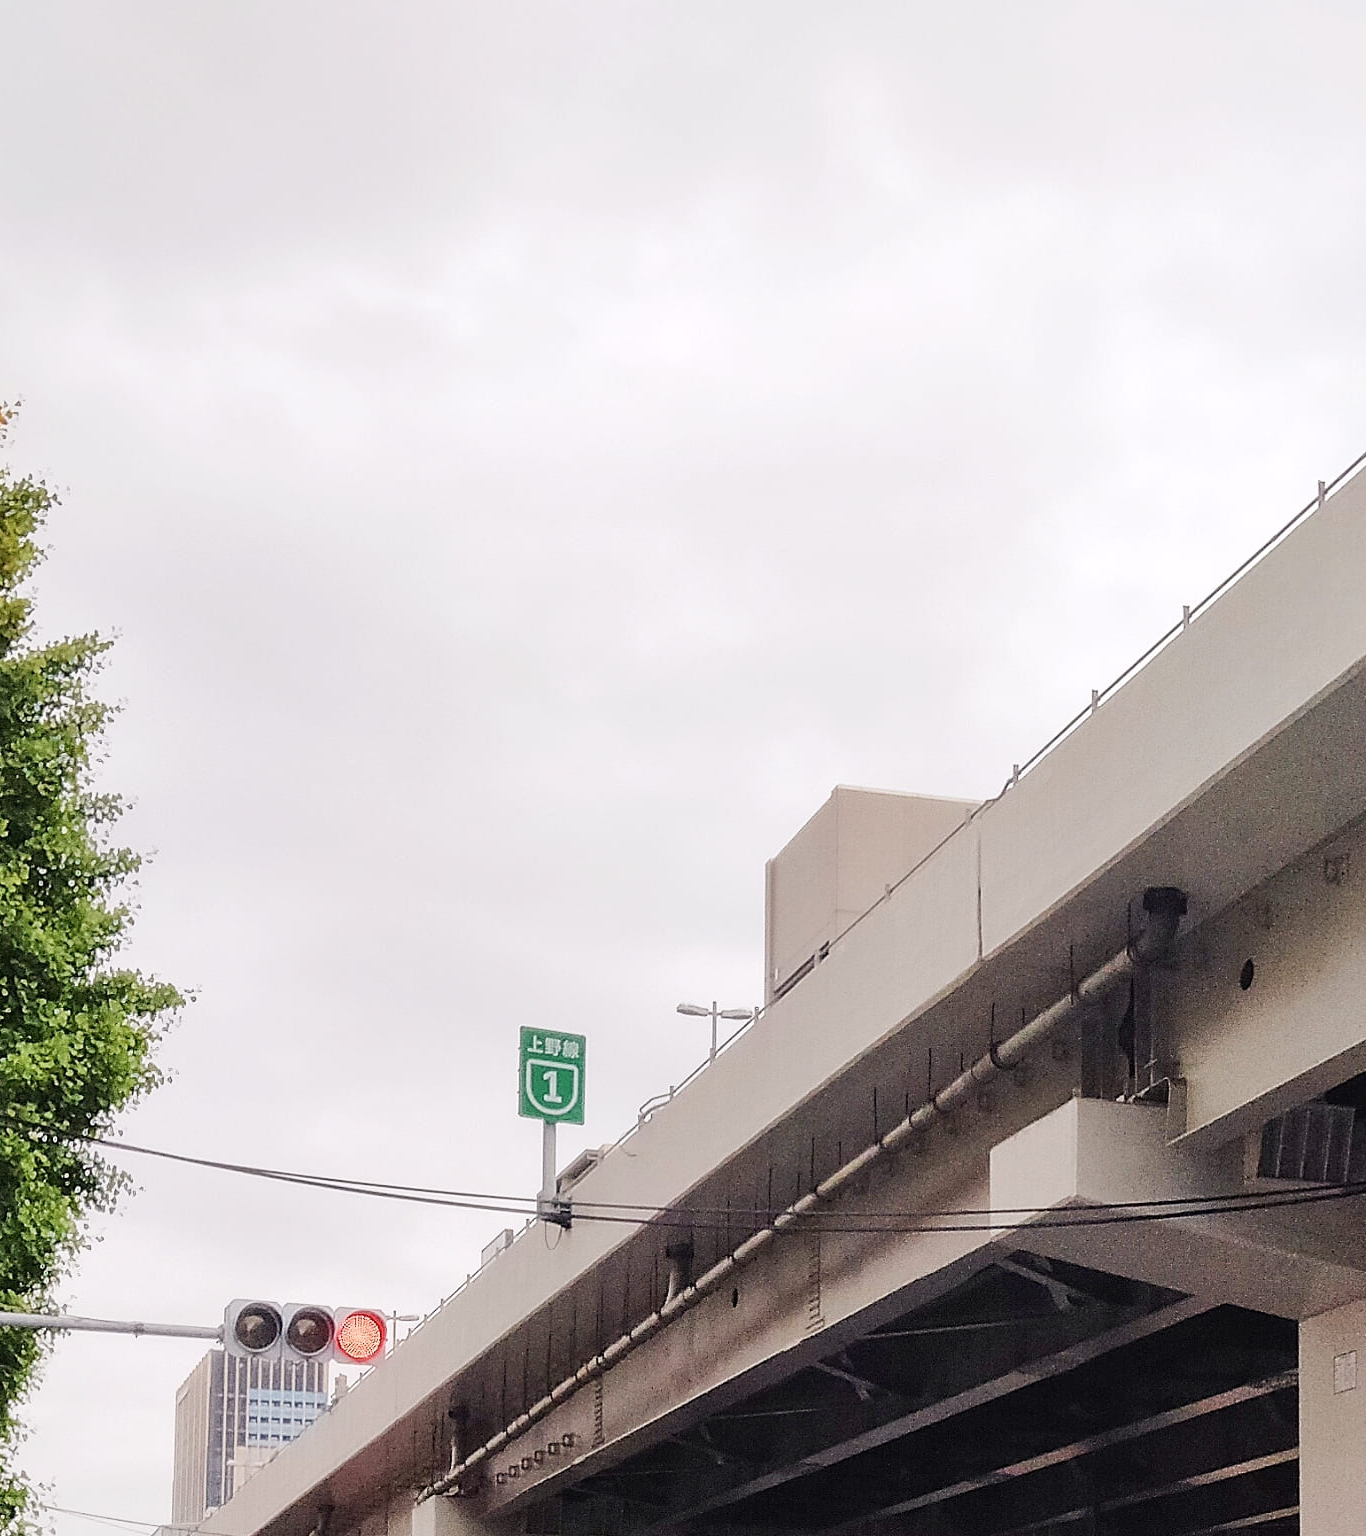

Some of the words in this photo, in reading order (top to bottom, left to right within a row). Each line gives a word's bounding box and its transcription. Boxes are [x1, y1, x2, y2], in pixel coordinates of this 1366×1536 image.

[527, 1035, 579, 1059] 上野線
[543, 1070, 562, 1103] 1
